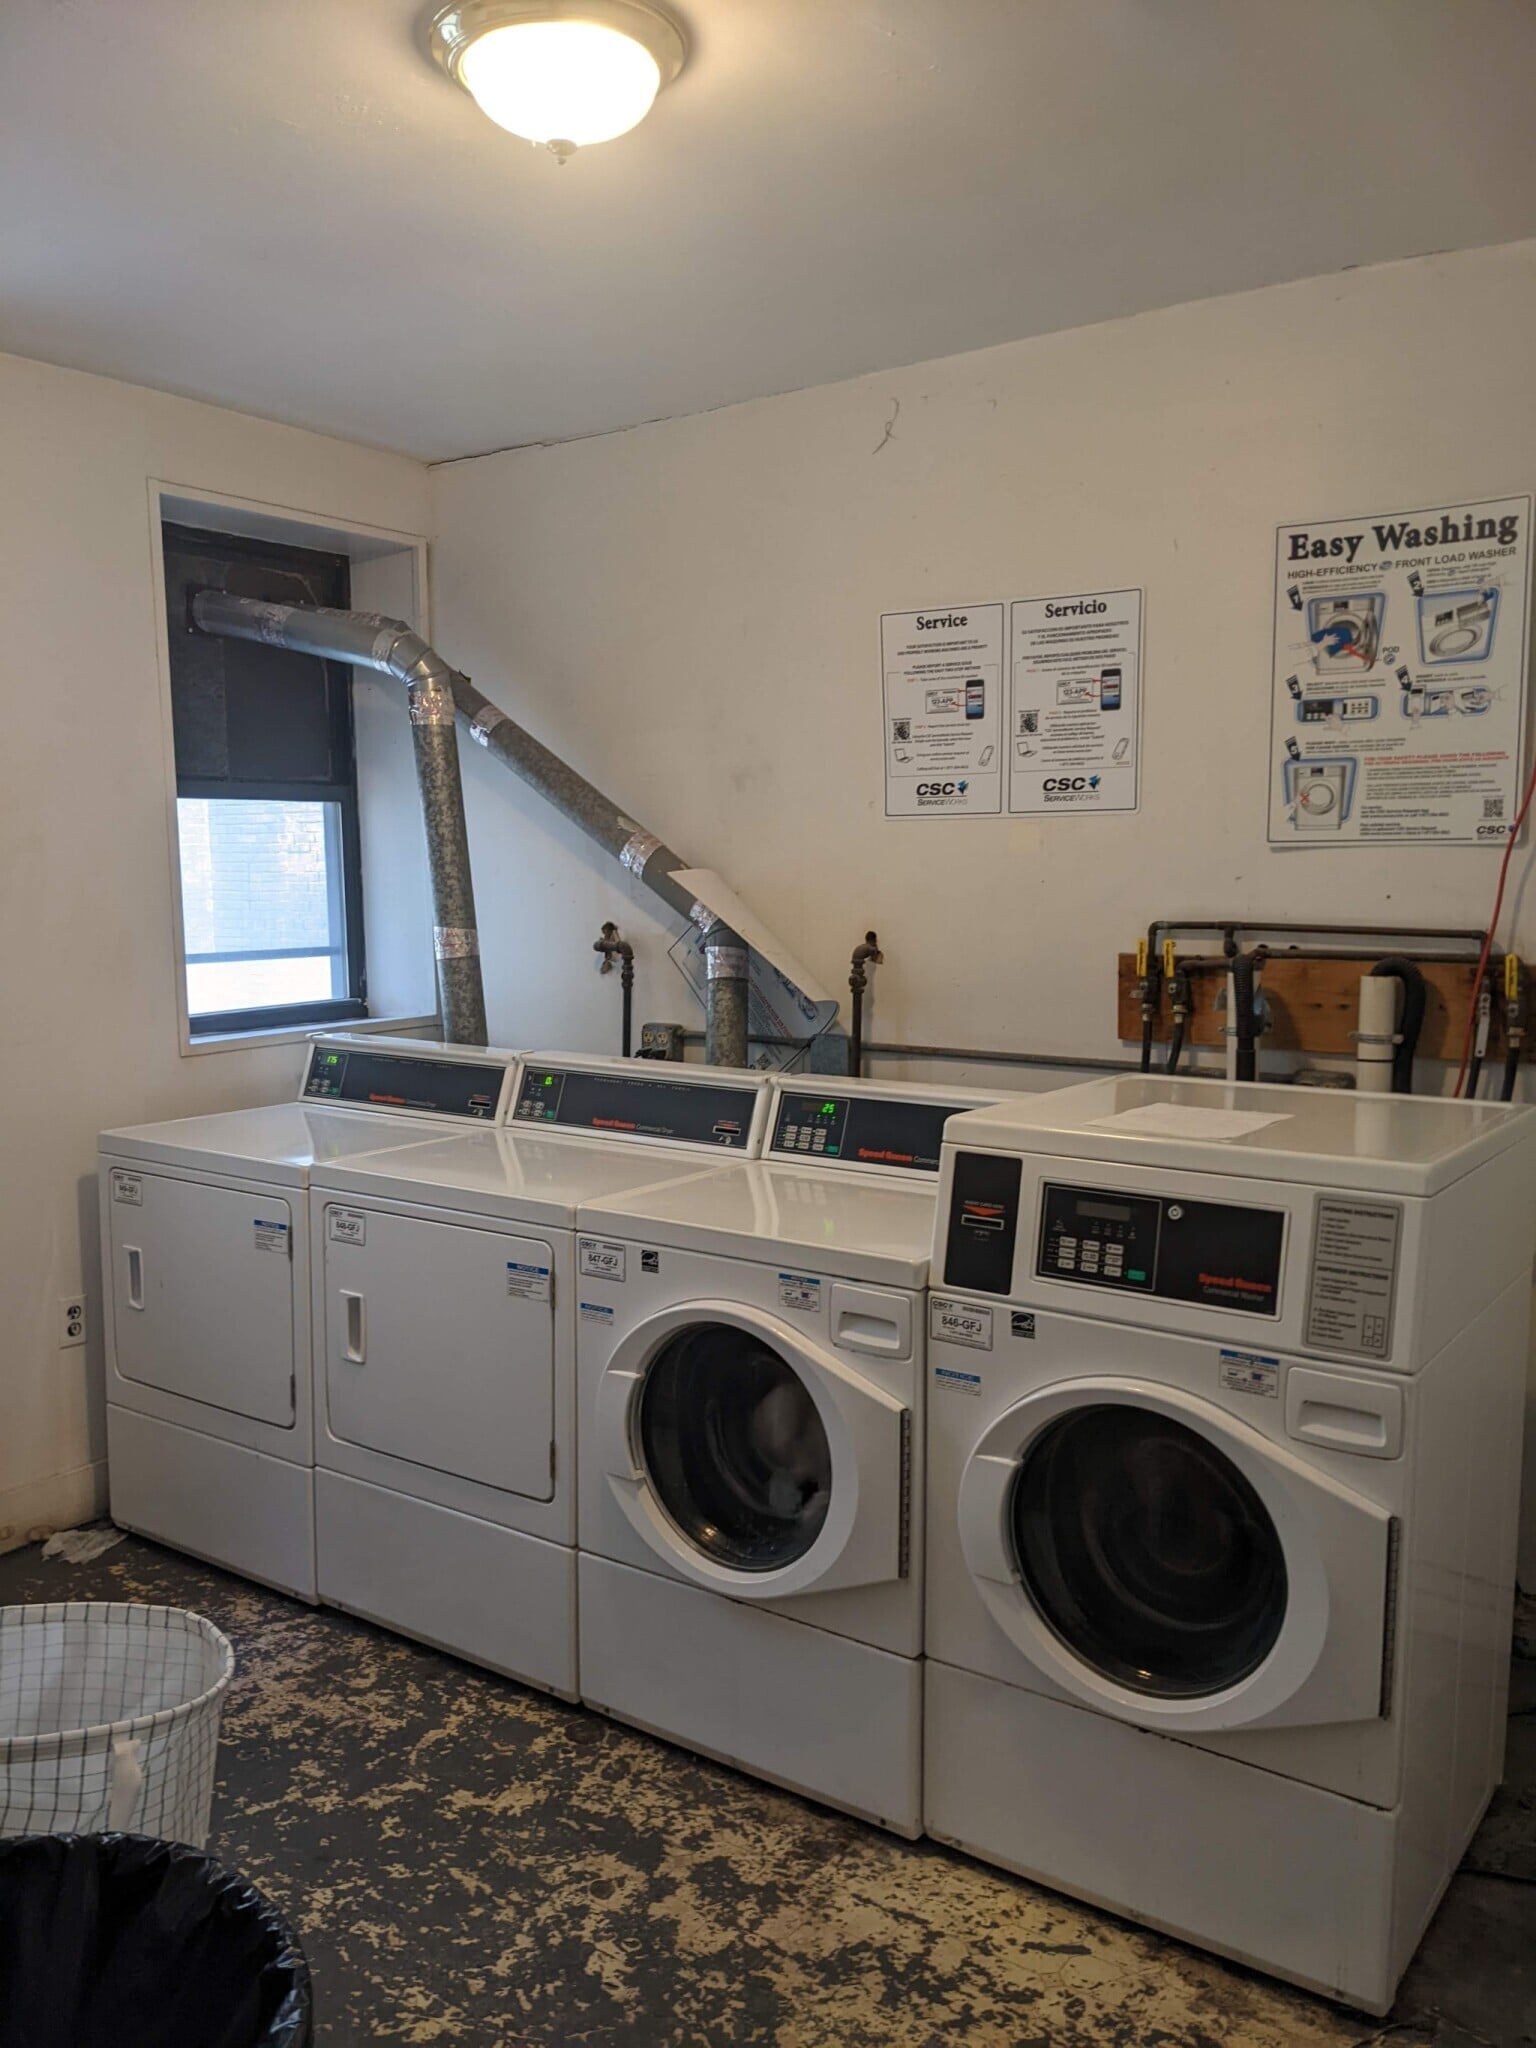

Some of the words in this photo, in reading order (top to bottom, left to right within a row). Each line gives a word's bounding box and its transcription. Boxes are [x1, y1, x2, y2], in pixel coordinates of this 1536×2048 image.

[1287, 533, 1364, 563] Easy
[1372, 513, 1519, 552] Washing
[1287, 563, 1378, 580] HIGH-EFFICIENCY
[1395, 557, 1432, 569] FRONT
[1435, 553, 1465, 565] LOAD
[1468, 546, 1517, 561] WASHER
[1413, 580, 1421, 590] 2
[1045, 600, 1107, 618] Servicio
[916, 614, 968, 631] Service
[1291, 683, 1298, 692] 3
[1289, 744, 1298, 755] 5
[916, 782, 955, 796] CSC
[1043, 777, 1086, 791] CSC
[1476, 825, 1506, 835] CSC
[821, 1103, 835, 1114] 25
[941, 1315, 982, 1332] 846-GFJ
